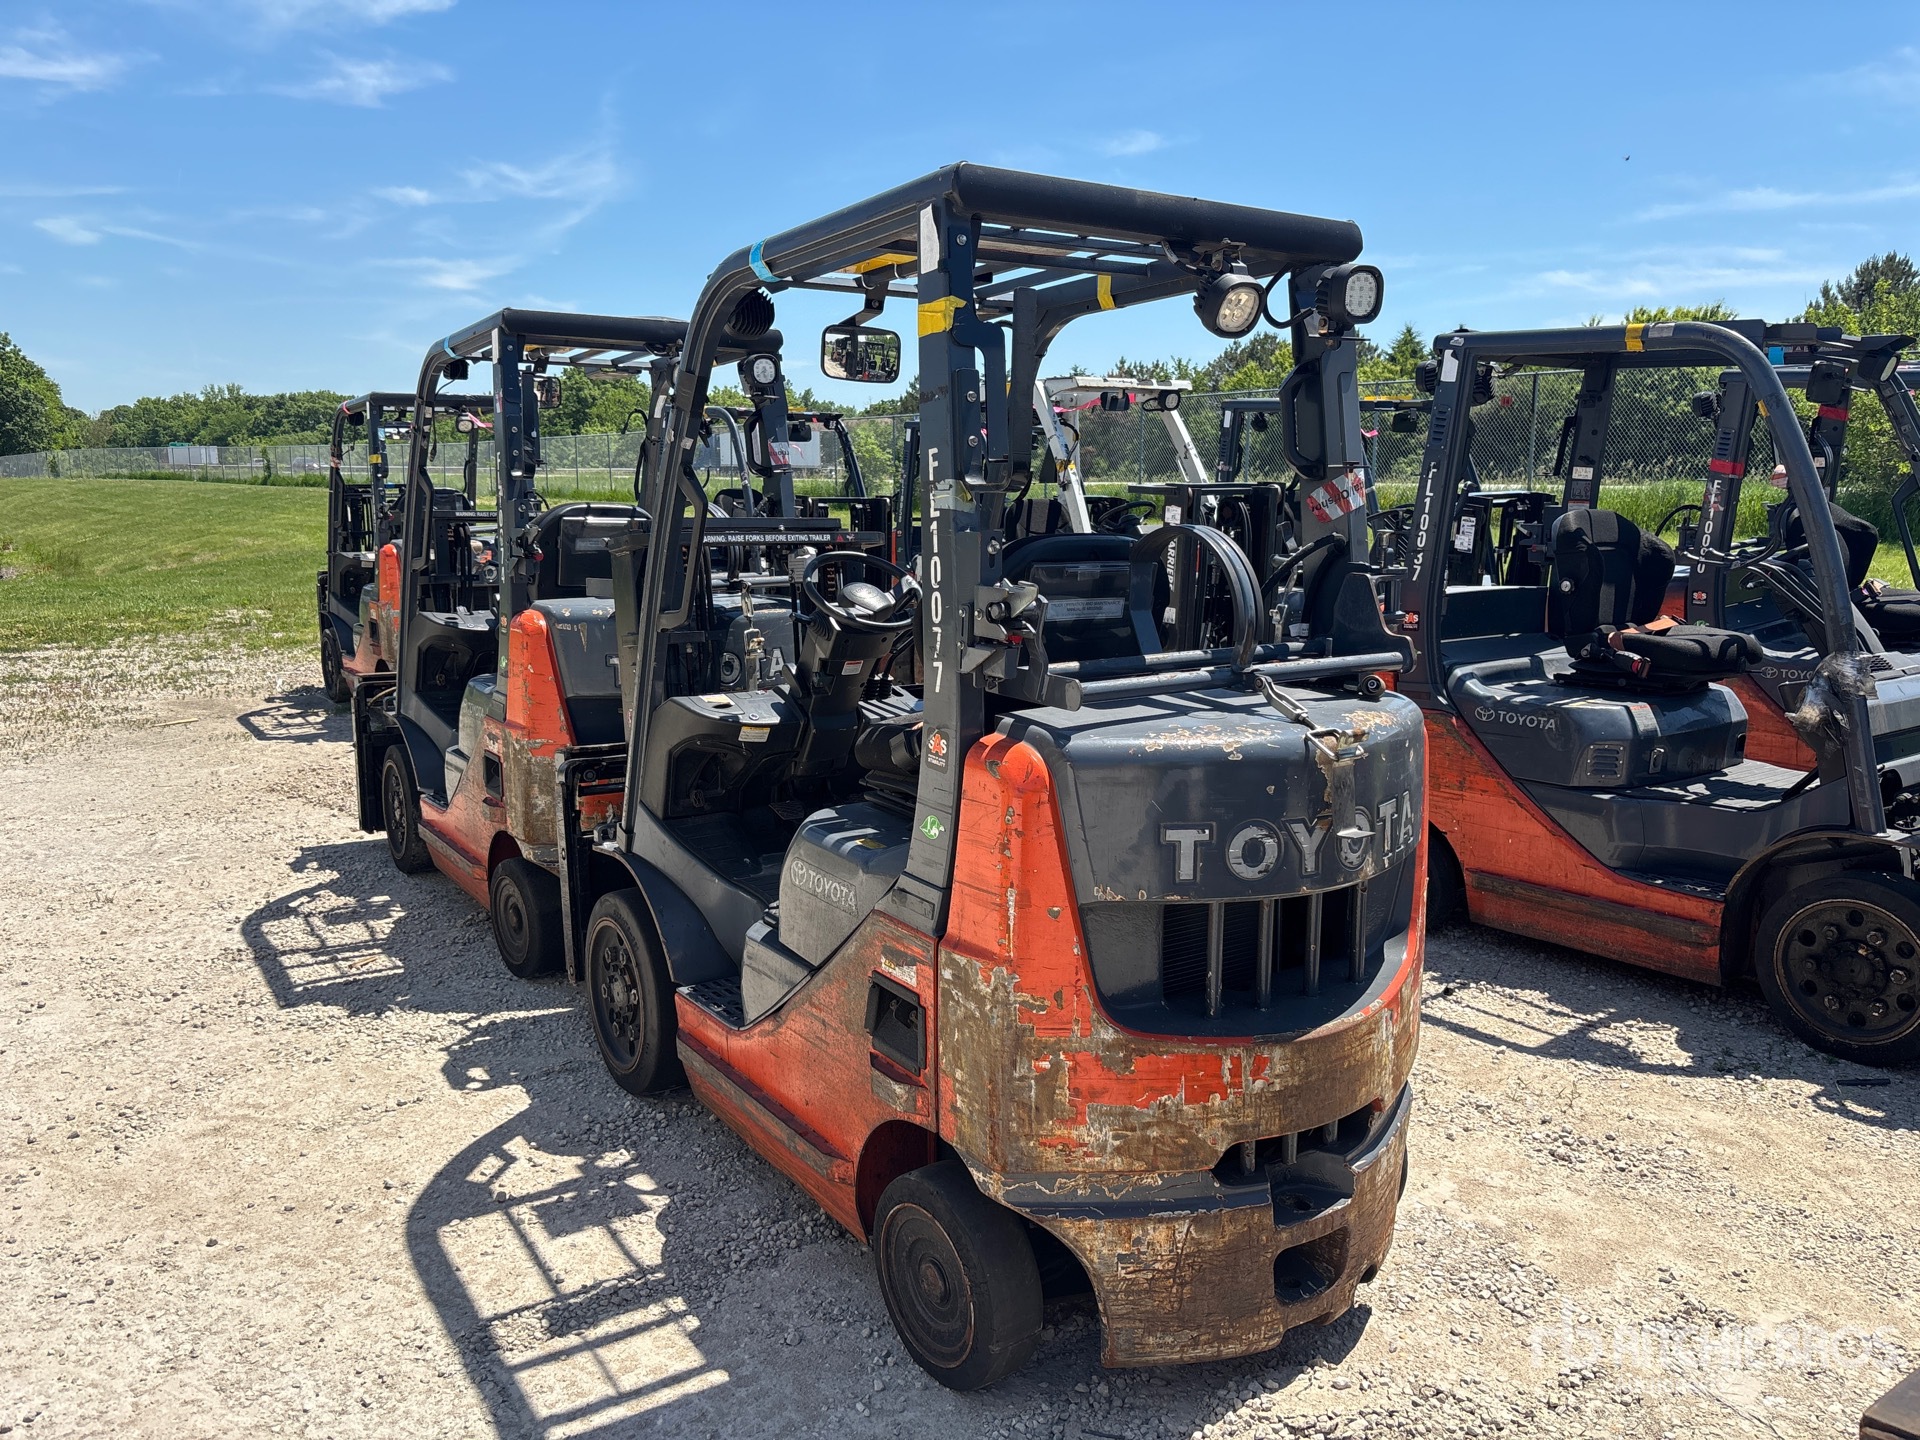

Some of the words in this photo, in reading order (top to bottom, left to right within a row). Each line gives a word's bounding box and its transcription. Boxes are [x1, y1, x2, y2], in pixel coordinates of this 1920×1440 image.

[703, 534, 727, 543] ARNING:
[727, 534, 745, 542] RAISE
[745, 534, 764, 542] FORKS
[765, 534, 787, 542] BEFORE
[809, 534, 830, 542] TRAILER
[1780, 668, 1815, 680] TOYO
[1498, 710, 1556, 732] TOYOTA
[928, 733, 948, 757] SAS
[1163, 789, 1416, 882] TOYOTA
[809, 869, 856, 911] TOYOTA
